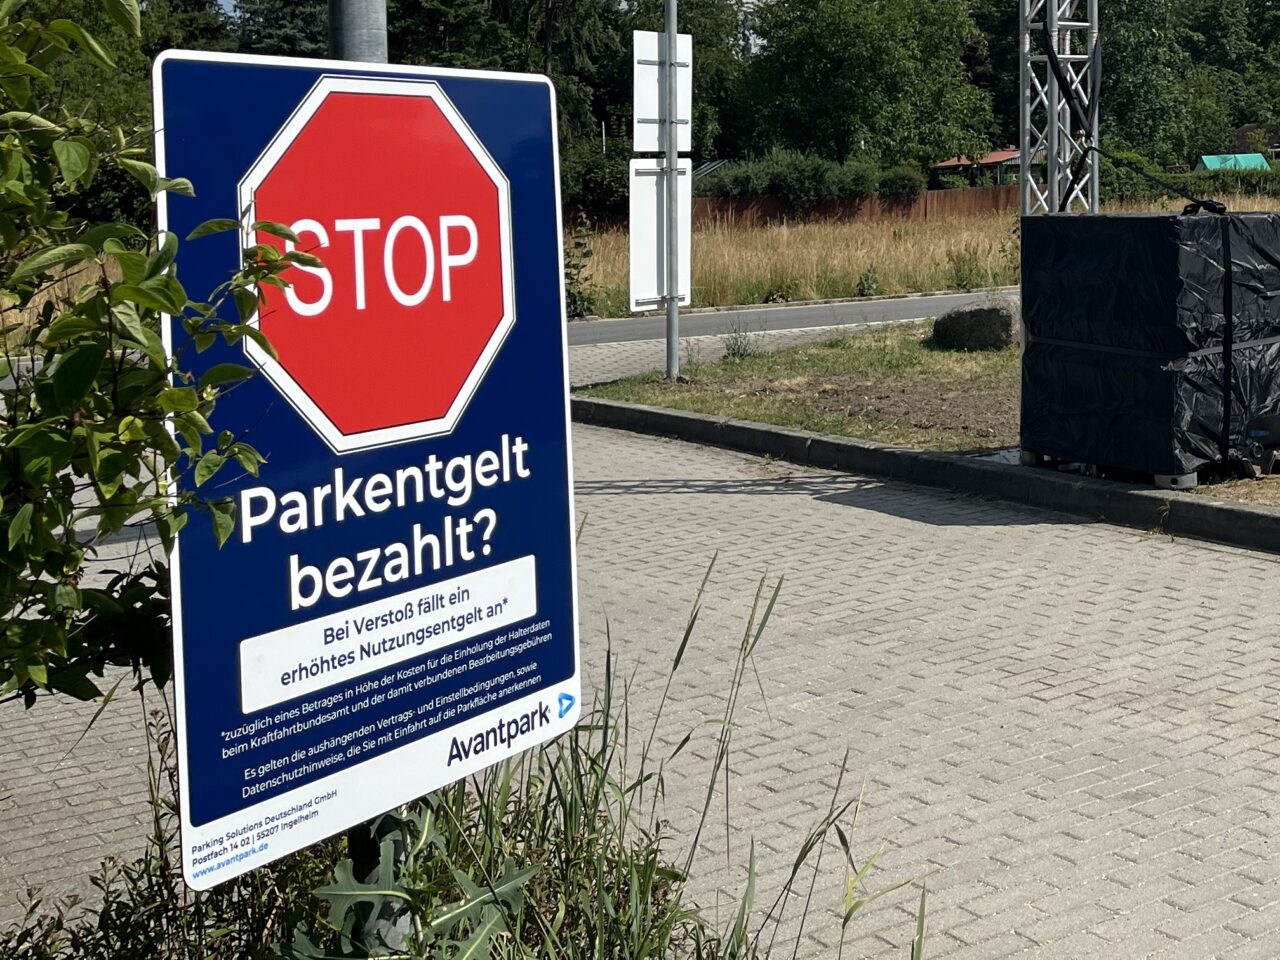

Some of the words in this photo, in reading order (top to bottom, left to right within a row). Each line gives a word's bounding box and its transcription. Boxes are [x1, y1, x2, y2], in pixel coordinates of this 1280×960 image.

[285, 214, 479, 317] STOP
[240, 434, 531, 543] Parkentgelt
[289, 508, 498, 611] bezahlt?
[280, 650, 356, 686] erhöhtes
[359, 606, 484, 661] Nutzungsentgelt
[323, 621, 350, 645] Bei
[353, 602, 414, 635] Verstoß
[417, 593, 445, 616] fällt
[448, 586, 471, 606] ein
[221, 743, 249, 759] beim
[250, 705, 350, 750] Kraftfahrtbundesamt
[351, 696, 370, 713] und
[370, 691, 386, 706] der
[387, 681, 413, 700] damit
[413, 663, 468, 690] verbundenen
[468, 632, 553, 670] Bearbeitungsgebühren
[244, 767, 257, 780] Es
[257, 756, 290, 778] gelten
[290, 748, 306, 762] die
[307, 723, 376, 757] aushängenden
[376, 709, 416, 730] Vertrags-
[417, 699, 434, 715] und
[435, 671, 516, 708] Einstellbedingungen,
[516, 661, 538, 677] sowie
[274, 707, 300, 724] eines
[302, 691, 343, 715] Betrages
[345, 688, 354, 699] in
[355, 678, 379, 695] Höhe
[380, 673, 395, 687] der
[396, 664, 426, 680] Kosten
[427, 658, 439, 670] für
[440, 653, 453, 666] die
[454, 640, 494, 661] Einholung
[494, 634, 507, 647] der
[508, 618, 551, 640] Halterdaten
[242, 752, 346, 799] Datenschutzhinweise,
[346, 743, 361, 758] die
[362, 737, 376, 752] Sie
[377, 731, 393, 746] mit
[394, 718, 428, 739] Einfahrt
[428, 712, 442, 726] auf
[442, 707, 456, 720] die
[457, 689, 498, 717] Parkfläche
[498, 674, 542, 699] anerkennen
[447, 700, 551, 767] Avantpark
[191, 835, 224, 855] Parking
[225, 819, 263, 841] Solutions
[264, 798, 313, 826] Deutschland
[314, 789, 338, 805] GmbH
[191, 841, 269, 879] www.avantpark.de
[192, 847, 229, 867] Postfach
[230, 841, 239, 852] 14
[240, 838, 251, 848] 02
[256, 825, 279, 841] 55207
[281, 809, 319, 831] Ingelheim
